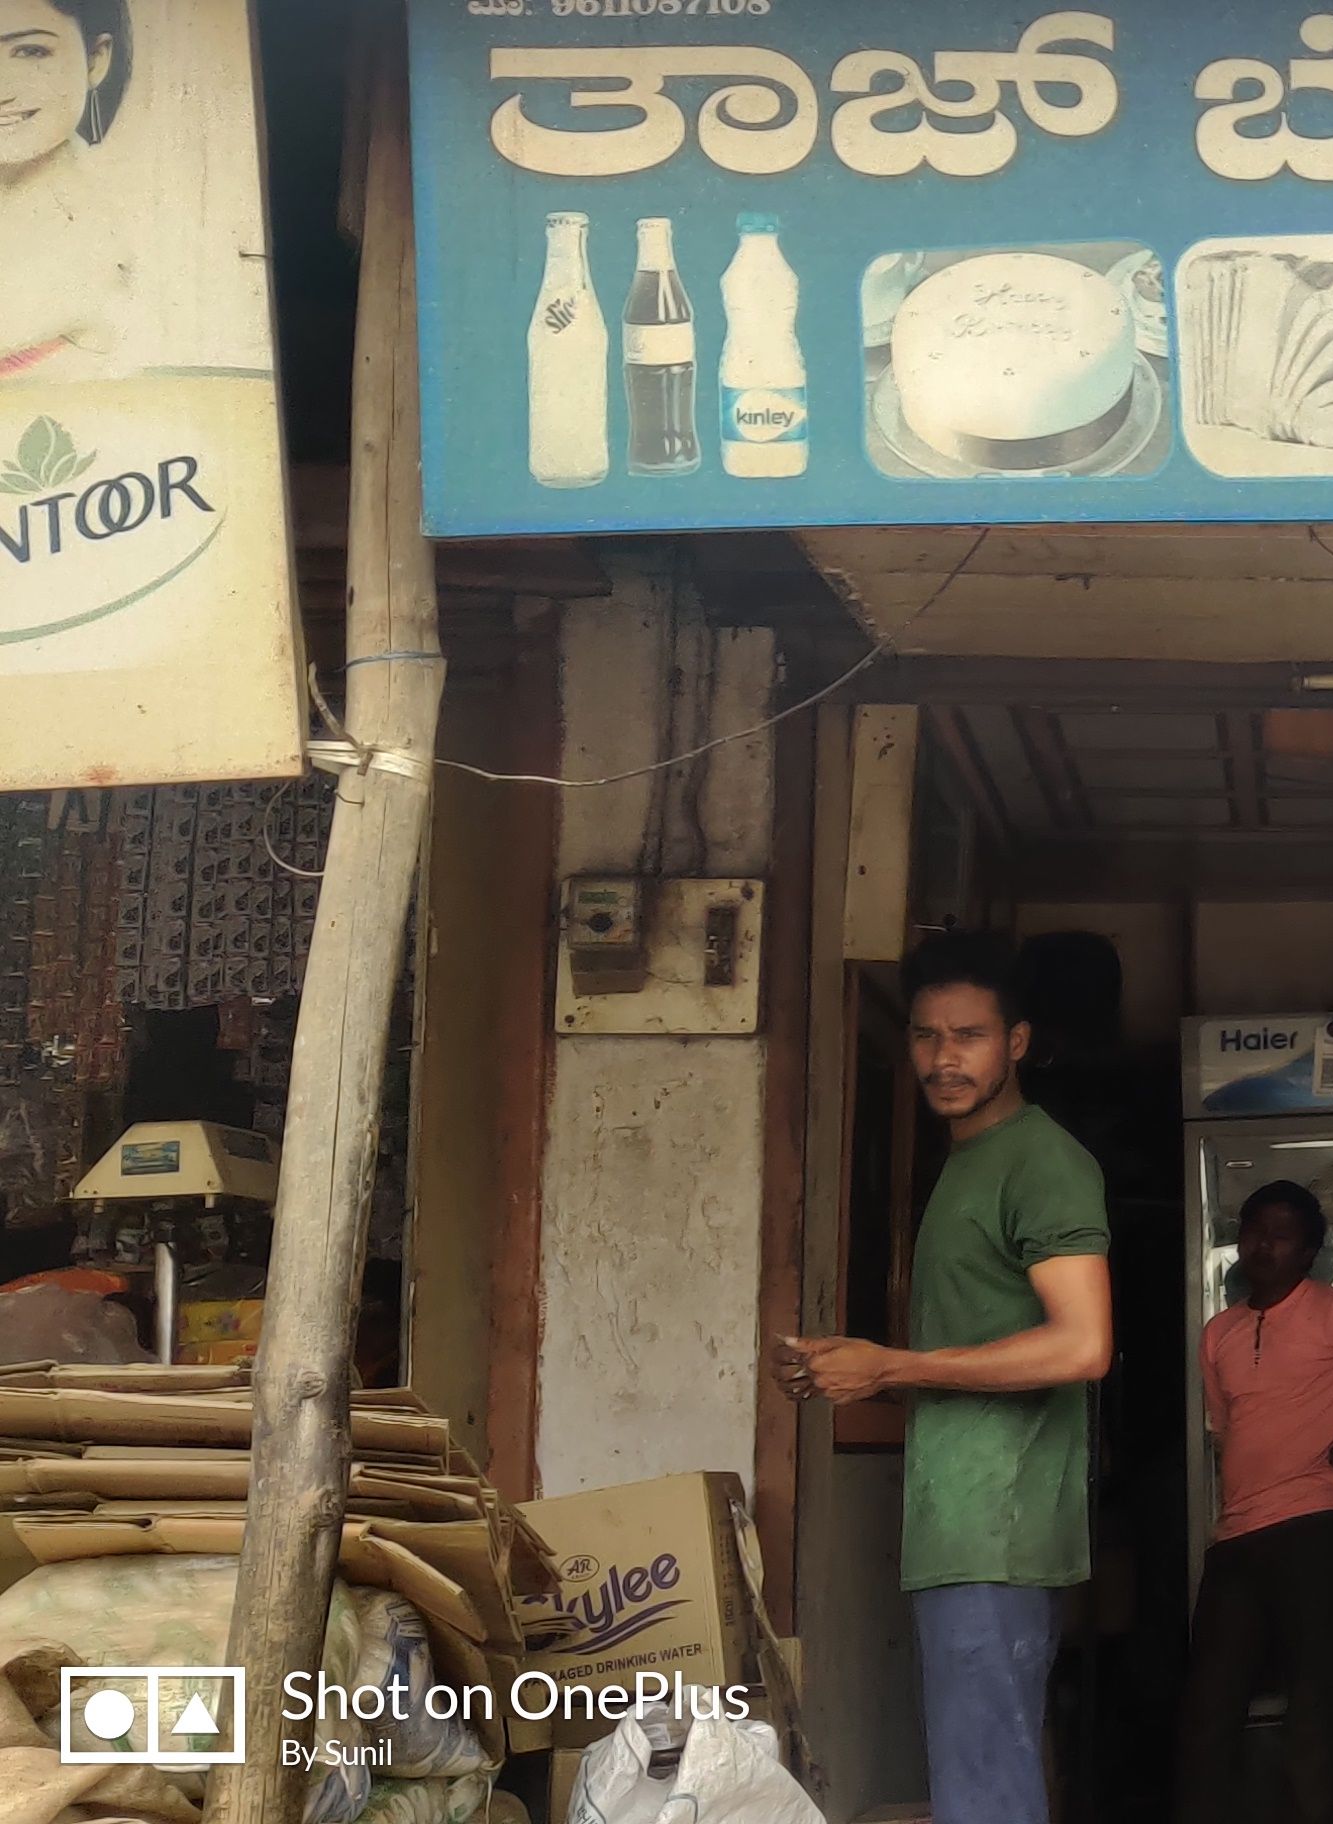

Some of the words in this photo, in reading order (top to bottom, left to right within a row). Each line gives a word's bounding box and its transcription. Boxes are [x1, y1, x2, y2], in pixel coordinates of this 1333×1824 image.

[490, 10, 1118, 177] ತಾಜ್
[736, 408, 795, 428] kinley
[1219, 1028, 1299, 1053] Haier
[596, 1652, 657, 1674] DRINKING
[660, 1643, 702, 1661] WATER
